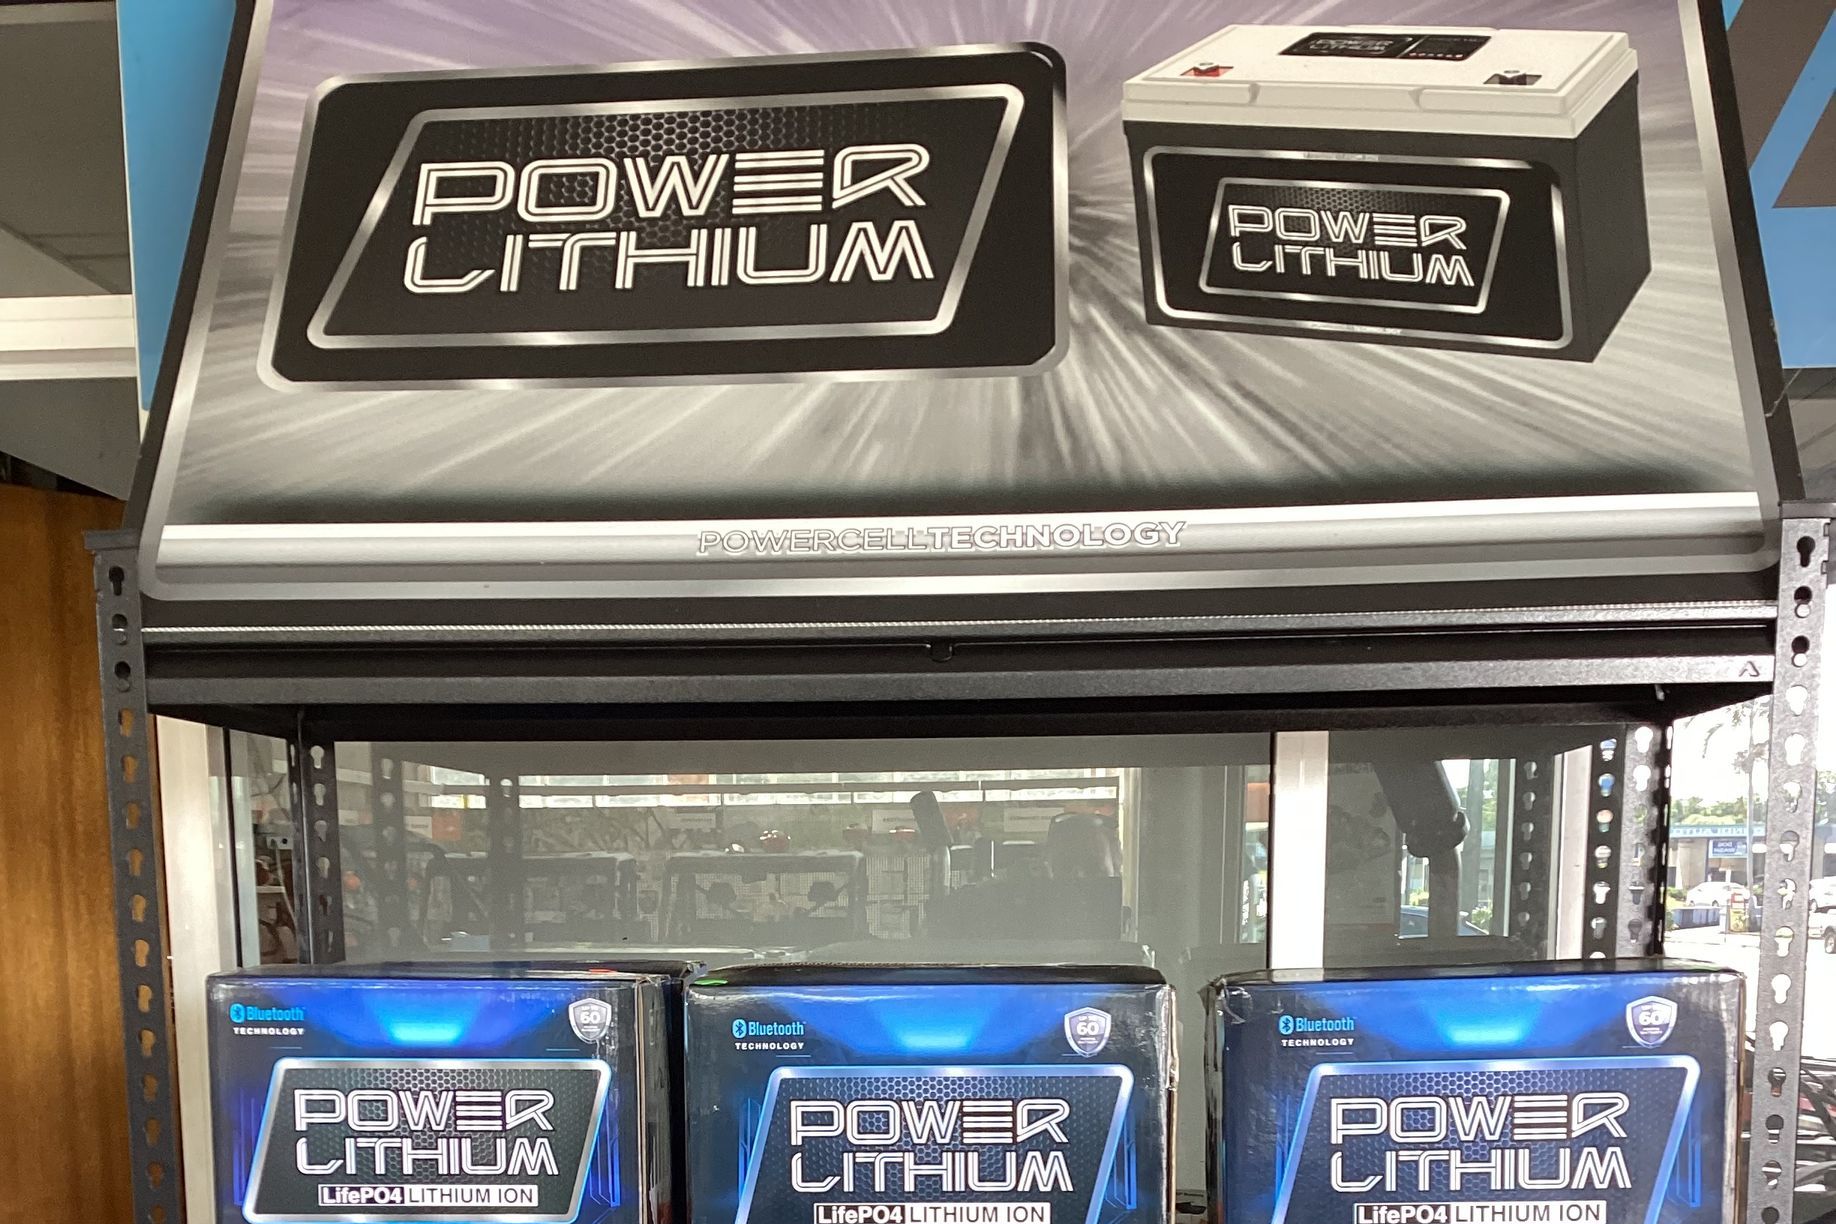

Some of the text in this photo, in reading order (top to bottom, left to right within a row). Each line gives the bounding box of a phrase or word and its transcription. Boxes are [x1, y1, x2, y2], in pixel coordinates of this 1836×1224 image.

[413, 143, 930, 225] POWER
[1227, 205, 1467, 249] POWER
[404, 220, 935, 293] LITHIUM
[1232, 240, 1475, 287] LITHIUM
[246, 1005, 304, 1022] Bluetooth
[1639, 1012, 1662, 1025] 60
[233, 1026, 304, 1035] TECHNOLOGY
[748, 1021, 804, 1037] Bluetooth
[1076, 1022, 1099, 1035] 60
[1295, 1016, 1355, 1033] Bluetooth
[735, 1042, 804, 1050] TECHNOLOGY
[1281, 1038, 1354, 1046] TECHNOLOGY
[294, 1089, 555, 1131] POWER
[1330, 1092, 1630, 1144] POWER
[790, 1098, 1071, 1146] POWER
[296, 1137, 560, 1176] LITHIUM
[790, 1150, 1074, 1193] LITHIUM
[1330, 1146, 1632, 1193] LITHIUM
[322, 1187, 533, 1204] LifePO4 LITHIUM ION
[818, 1205, 1044, 1224] LifePO4 LITHIUM ION
[1357, 1203, 1599, 1224] LifePO4 LITHIUM ION
